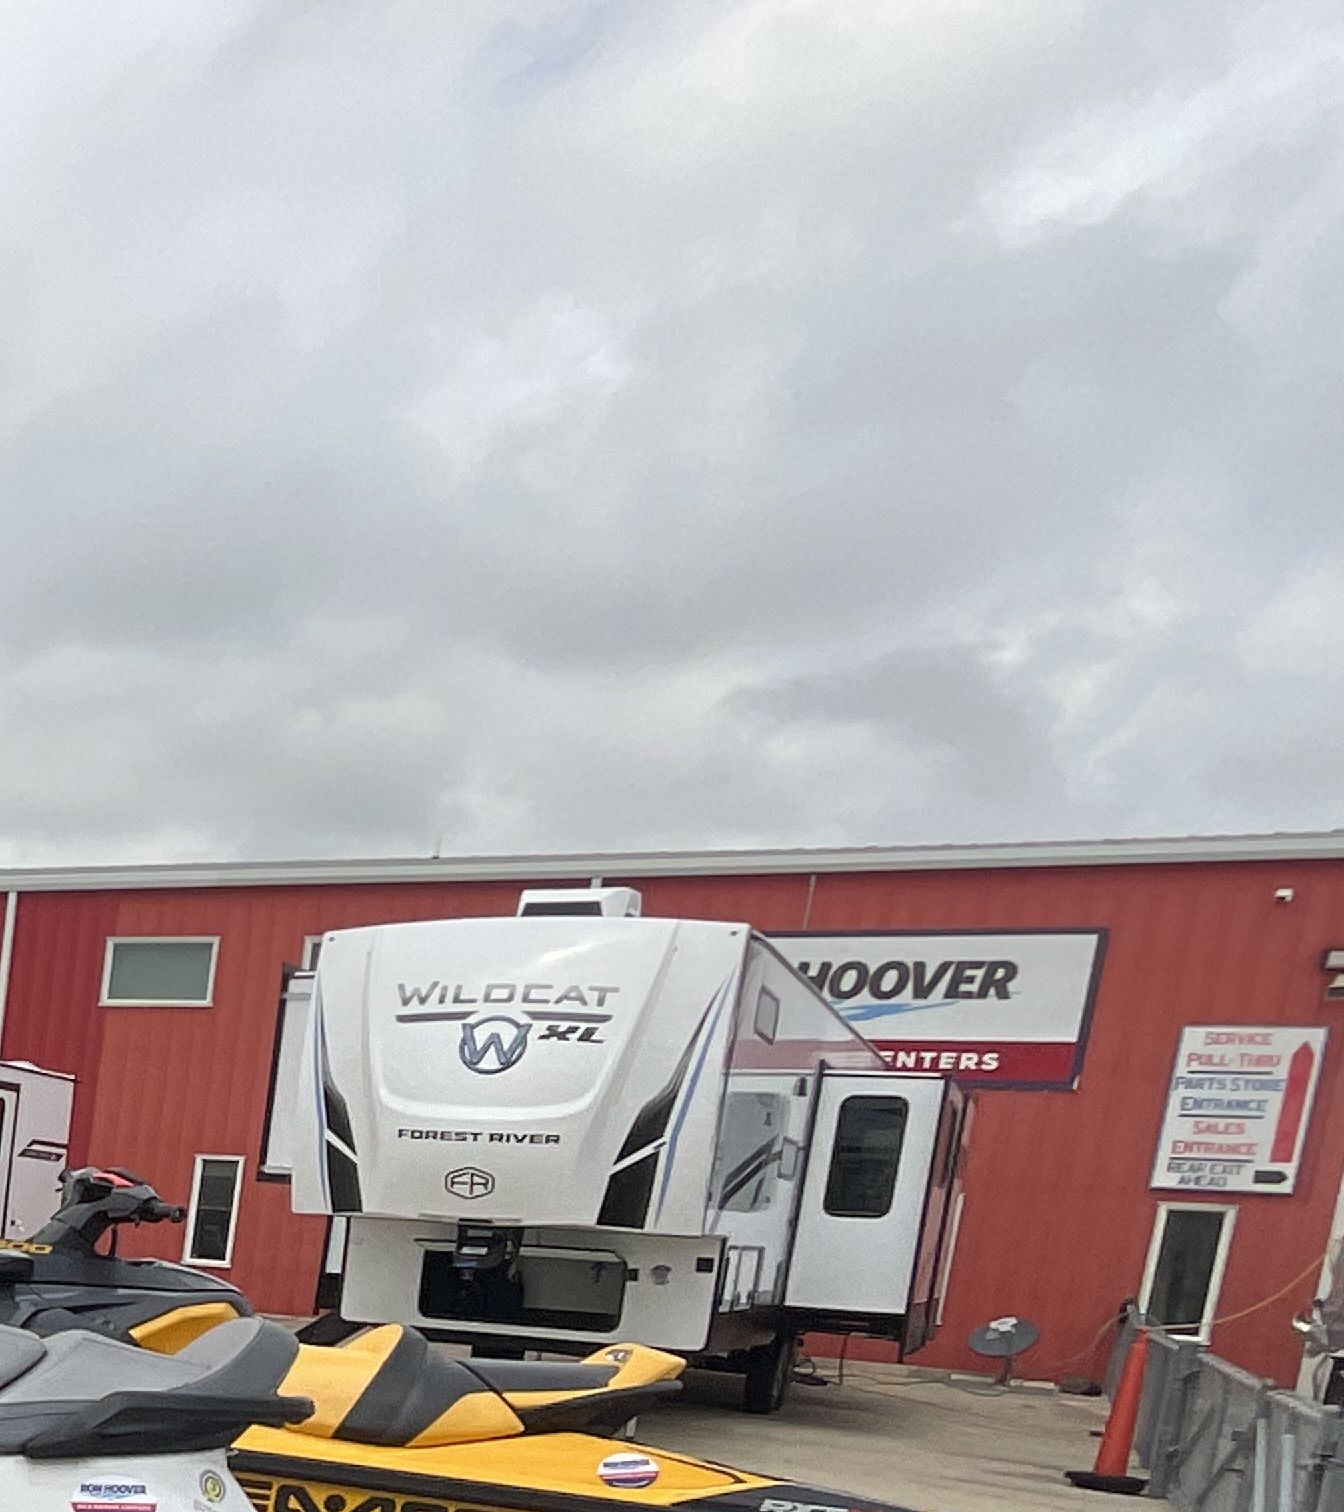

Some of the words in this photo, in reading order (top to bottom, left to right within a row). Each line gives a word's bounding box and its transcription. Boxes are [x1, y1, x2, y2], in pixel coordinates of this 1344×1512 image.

[797, 960, 1018, 1000] HOOVER
[397, 981, 620, 1007] WILDCAT
[536, 1024, 605, 1043] XL
[879, 1051, 1000, 1071] ENTERS
[397, 1128, 484, 1142] FOREST
[488, 1131, 561, 1144] RIVER
[1192, 1121, 1246, 1135] SALES
